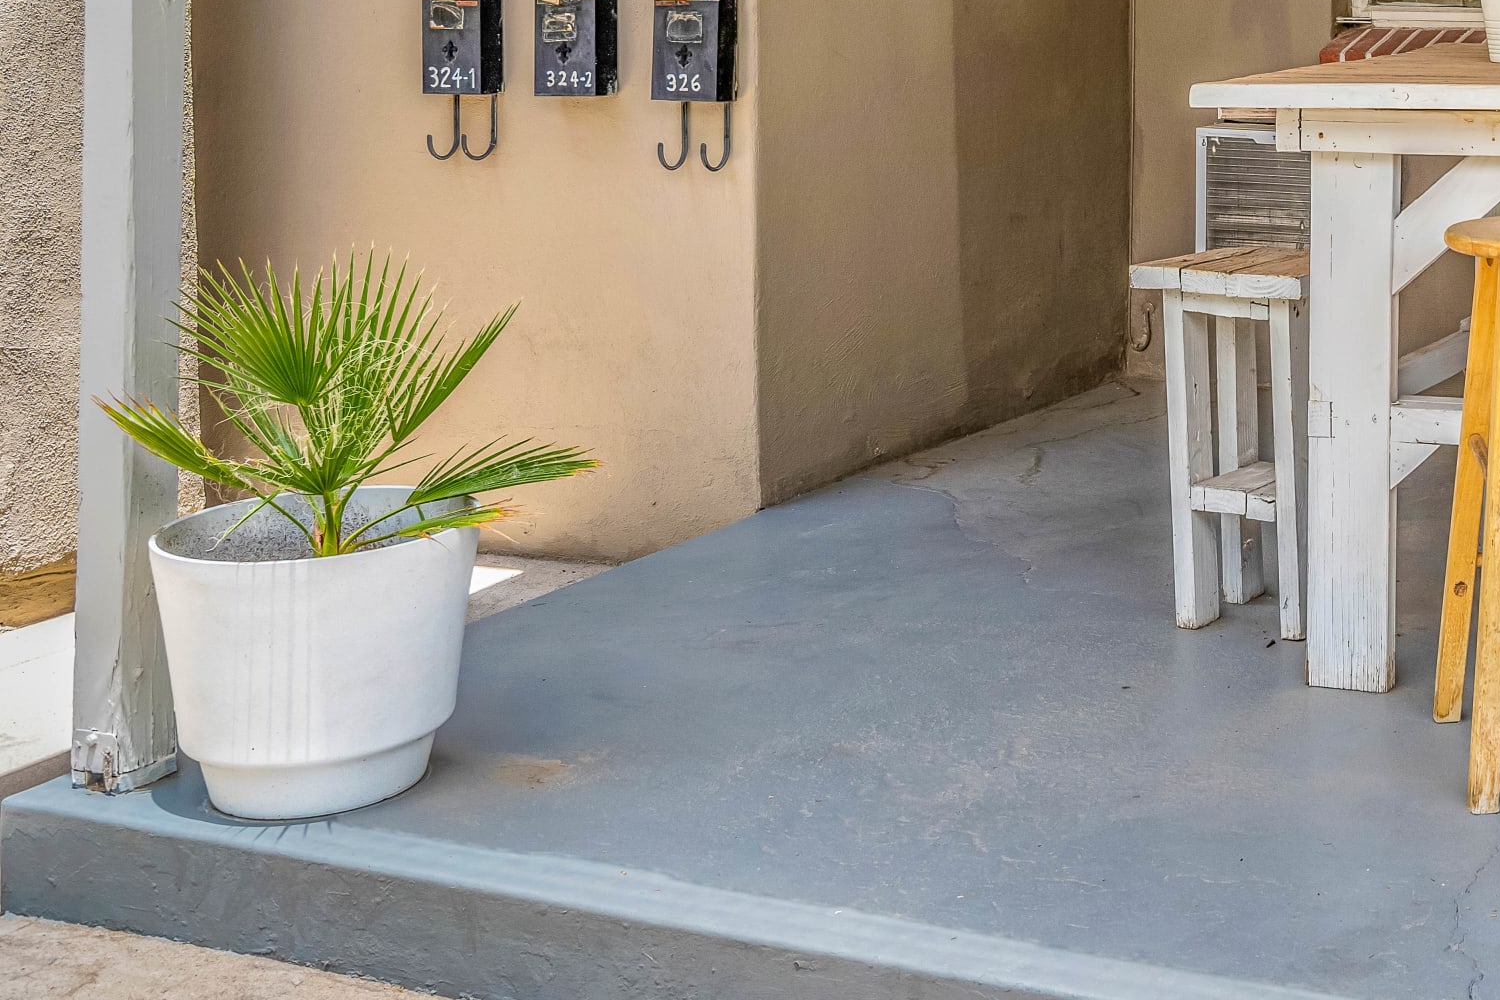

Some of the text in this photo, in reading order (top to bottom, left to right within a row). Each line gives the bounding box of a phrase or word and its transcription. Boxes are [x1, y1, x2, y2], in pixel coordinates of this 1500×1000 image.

[429, 66, 476, 88] 324-1
[546, 70, 593, 88] 324-2
[666, 73, 701, 92] 326
